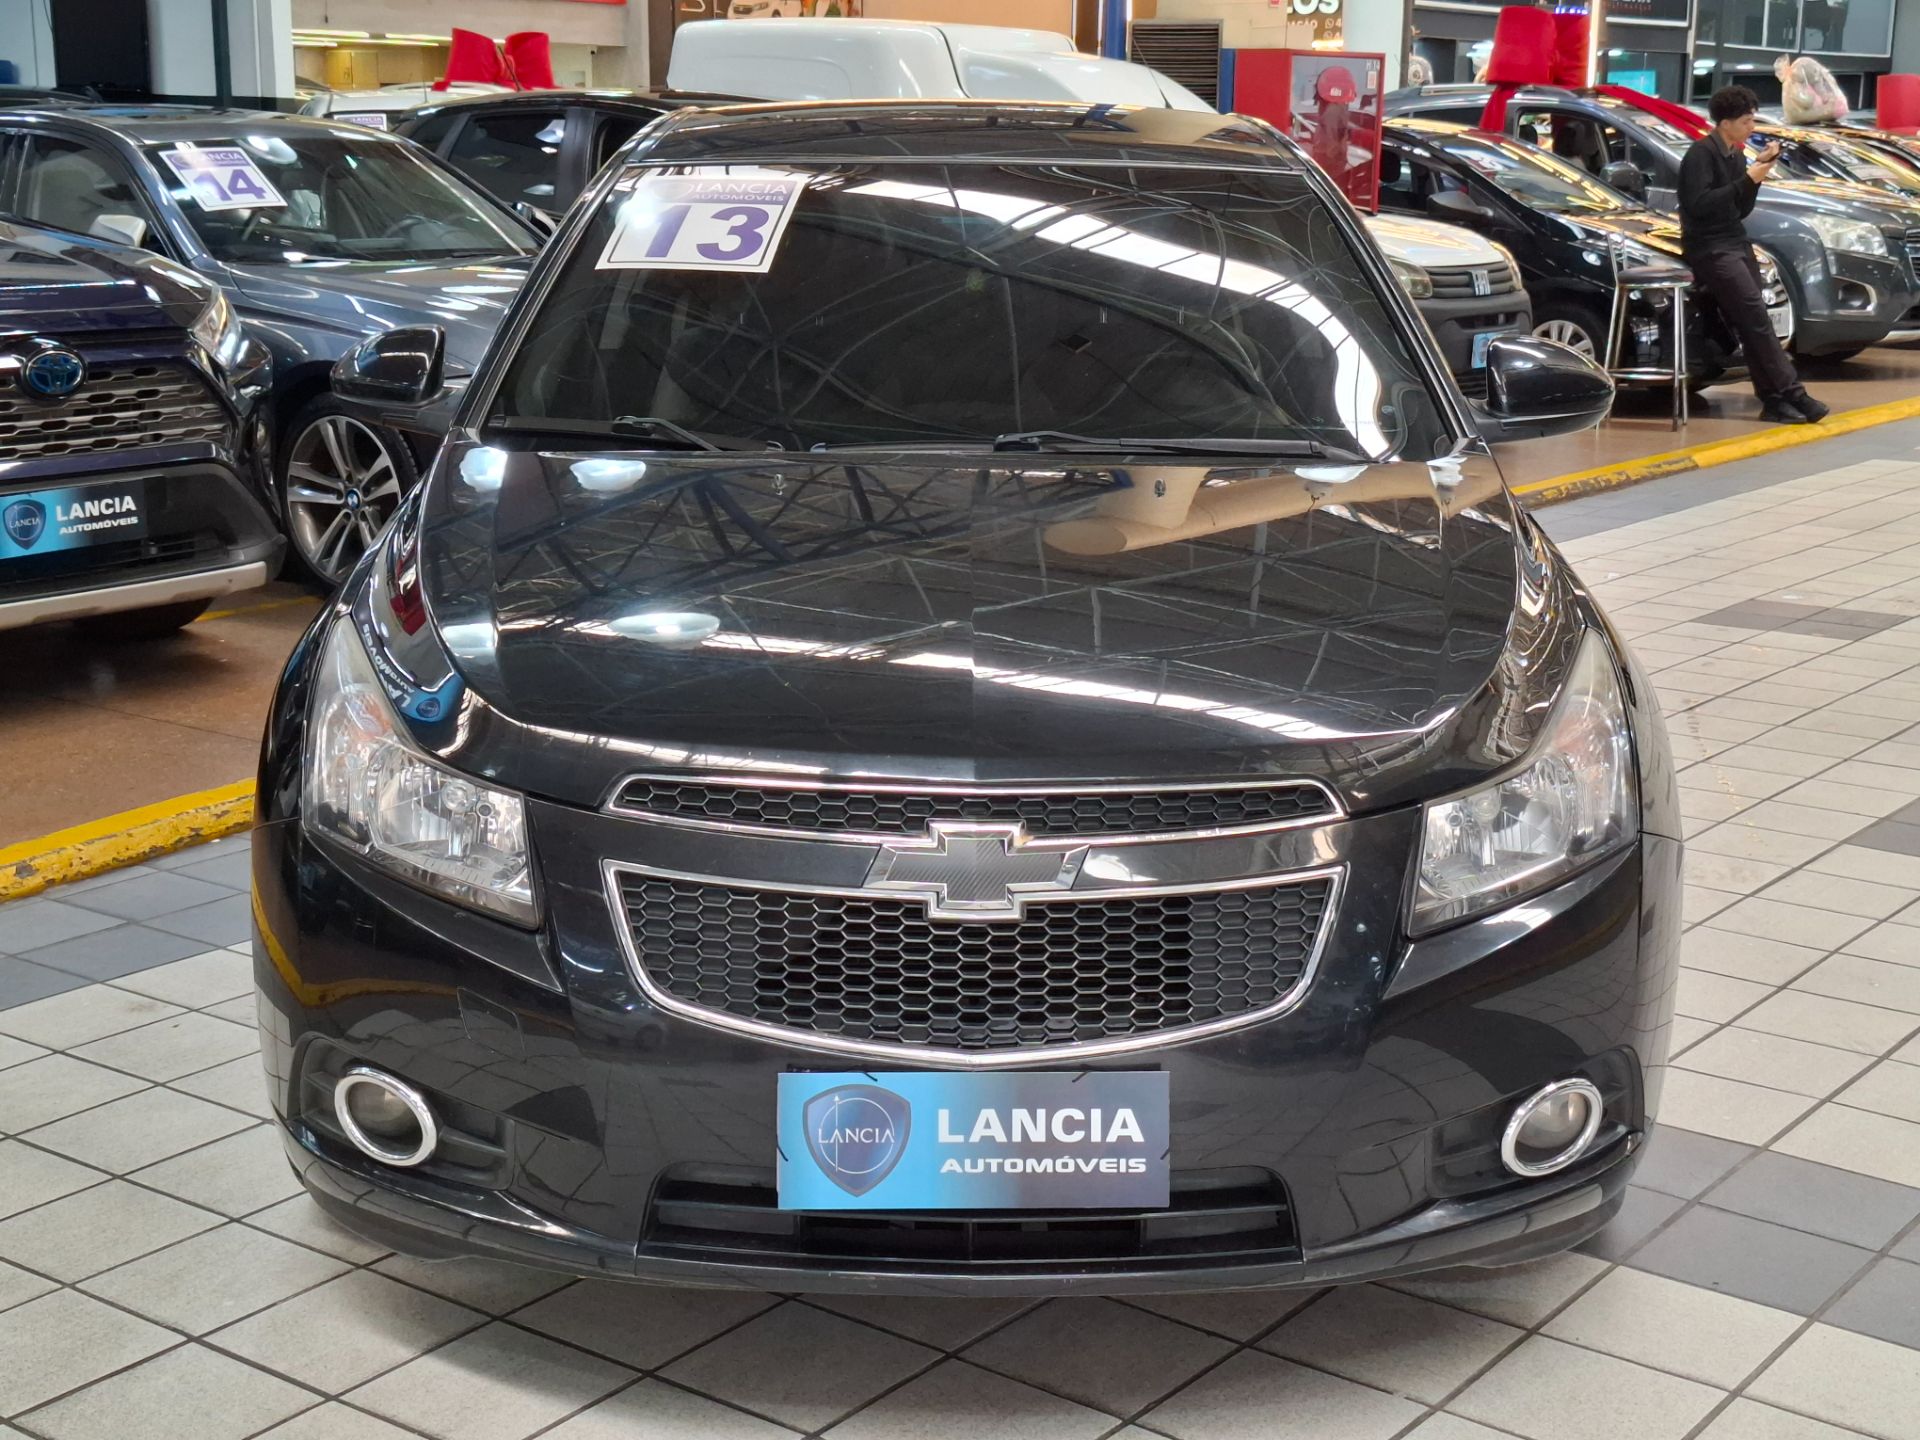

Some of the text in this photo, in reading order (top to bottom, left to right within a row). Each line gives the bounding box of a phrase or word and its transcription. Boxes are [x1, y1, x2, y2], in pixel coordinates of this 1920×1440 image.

[193, 169, 266, 202] 14
[696, 182, 788, 195] LANCIA
[644, 204, 770, 261] 13
[56, 495, 137, 522] LANCIA
[59, 516, 139, 535] AUTOMÓVEIS
[817, 1127, 896, 1145] LANCIA
[937, 1107, 1145, 1144] LANCIA
[939, 1154, 1147, 1174] AUTOMÓVEIS
